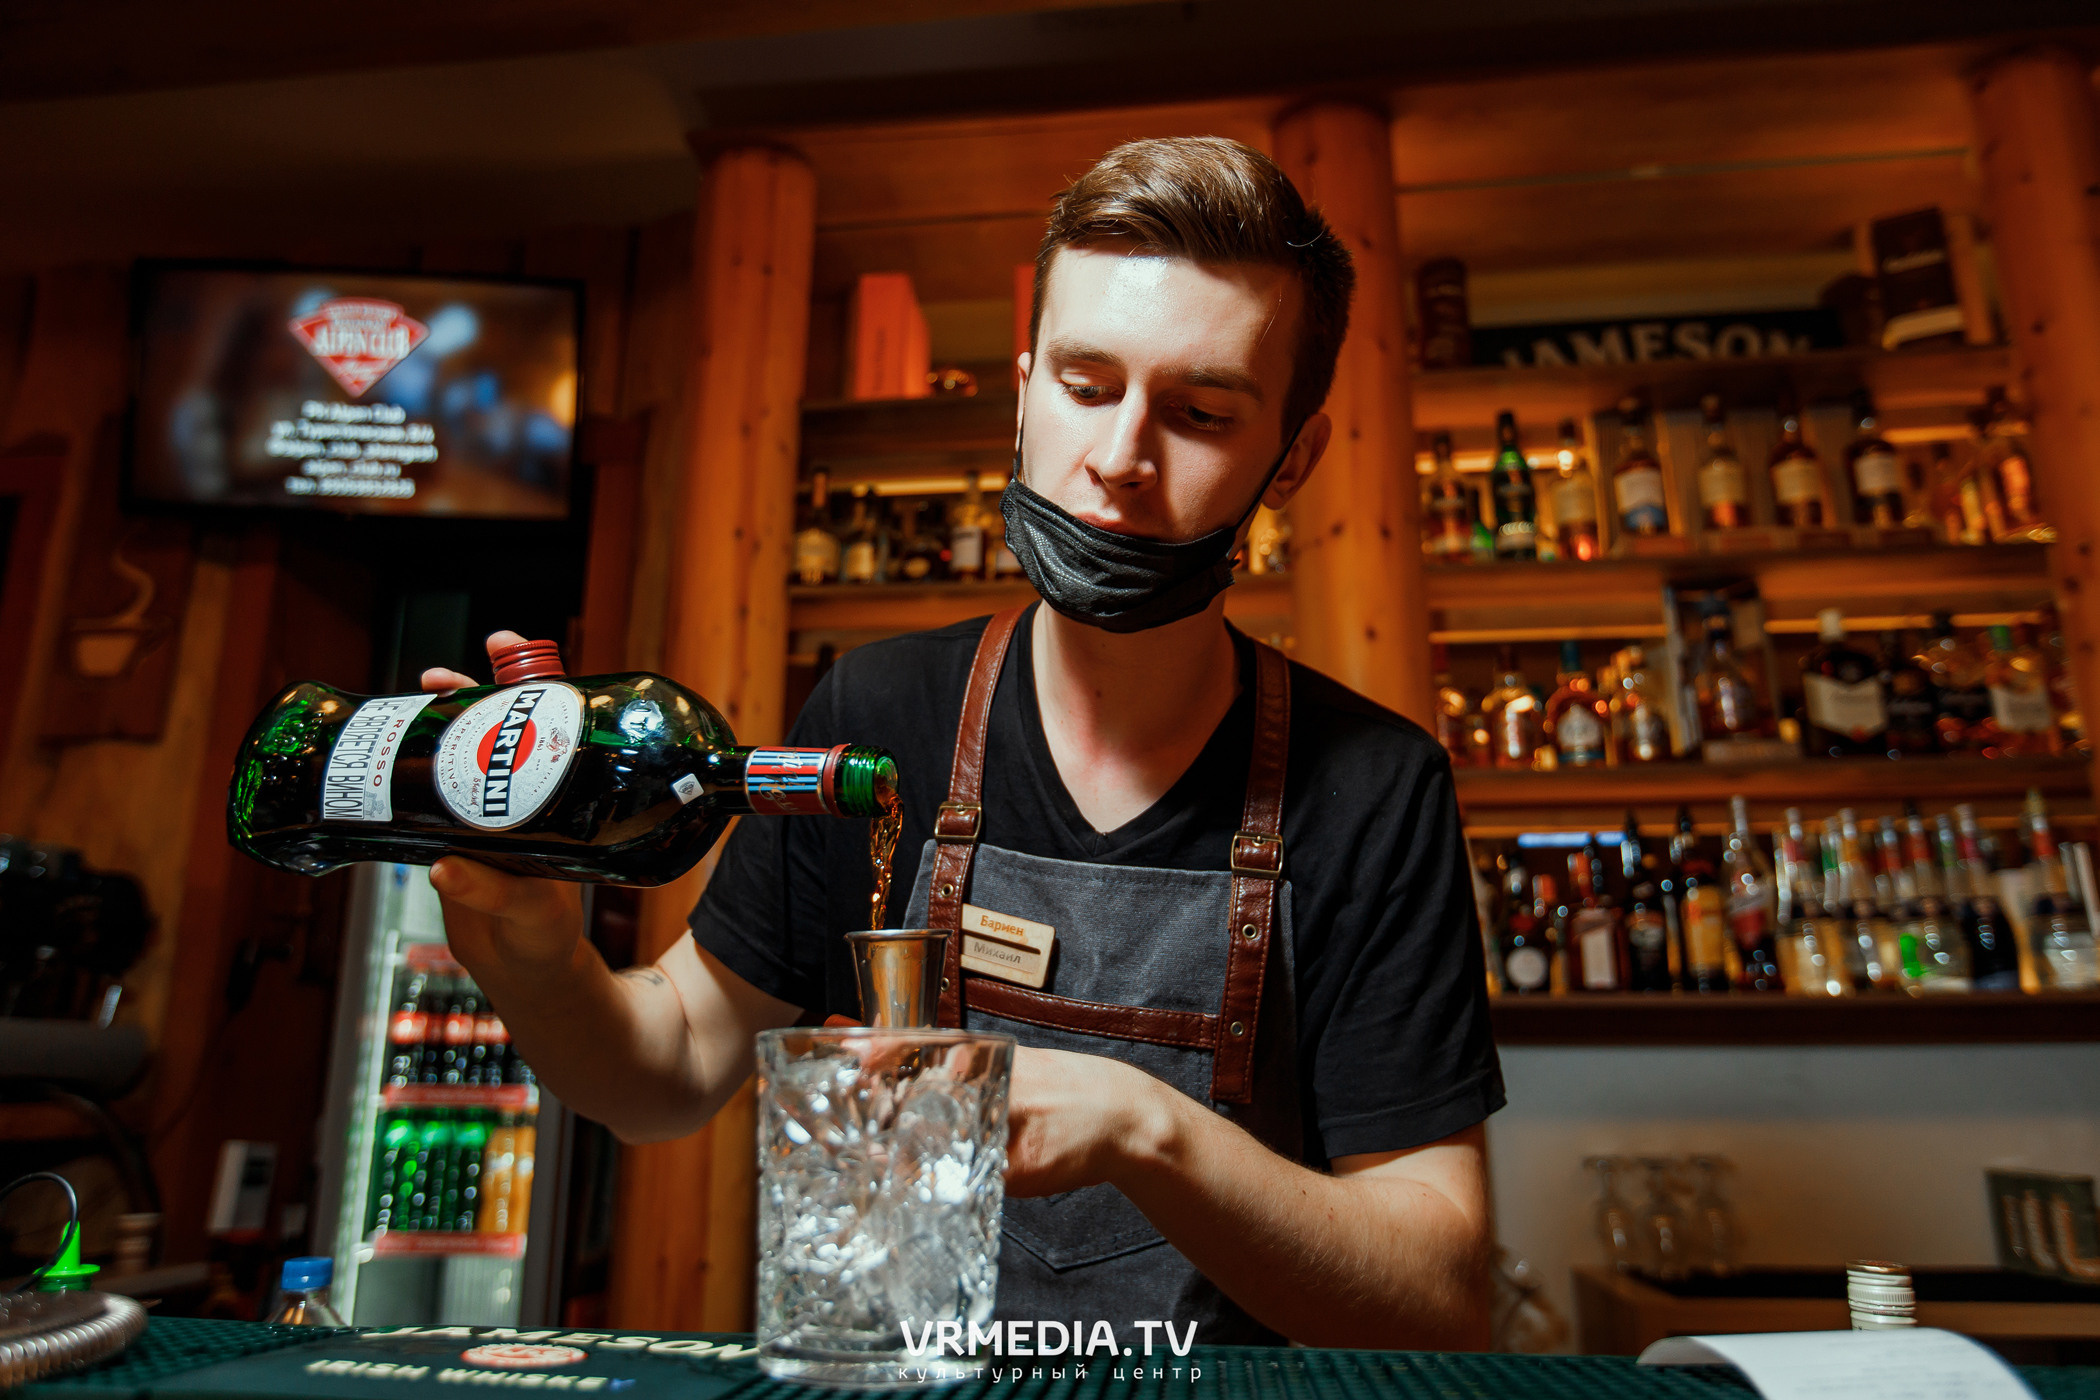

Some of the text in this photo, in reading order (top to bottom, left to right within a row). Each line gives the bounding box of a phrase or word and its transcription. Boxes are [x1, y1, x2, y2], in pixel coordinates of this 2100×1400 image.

[330, 715, 392, 769] ЯВЛЯЕТСЯ
[373, 719, 405, 787] ROSSO
[485, 692, 543, 812] MARTINI
[324, 775, 366, 818] ВИНОМ
[980, 914, 1025, 937] Бармен
[973, 941, 1021, 964] Михаил
[304, 1358, 431, 1381] IRISH
